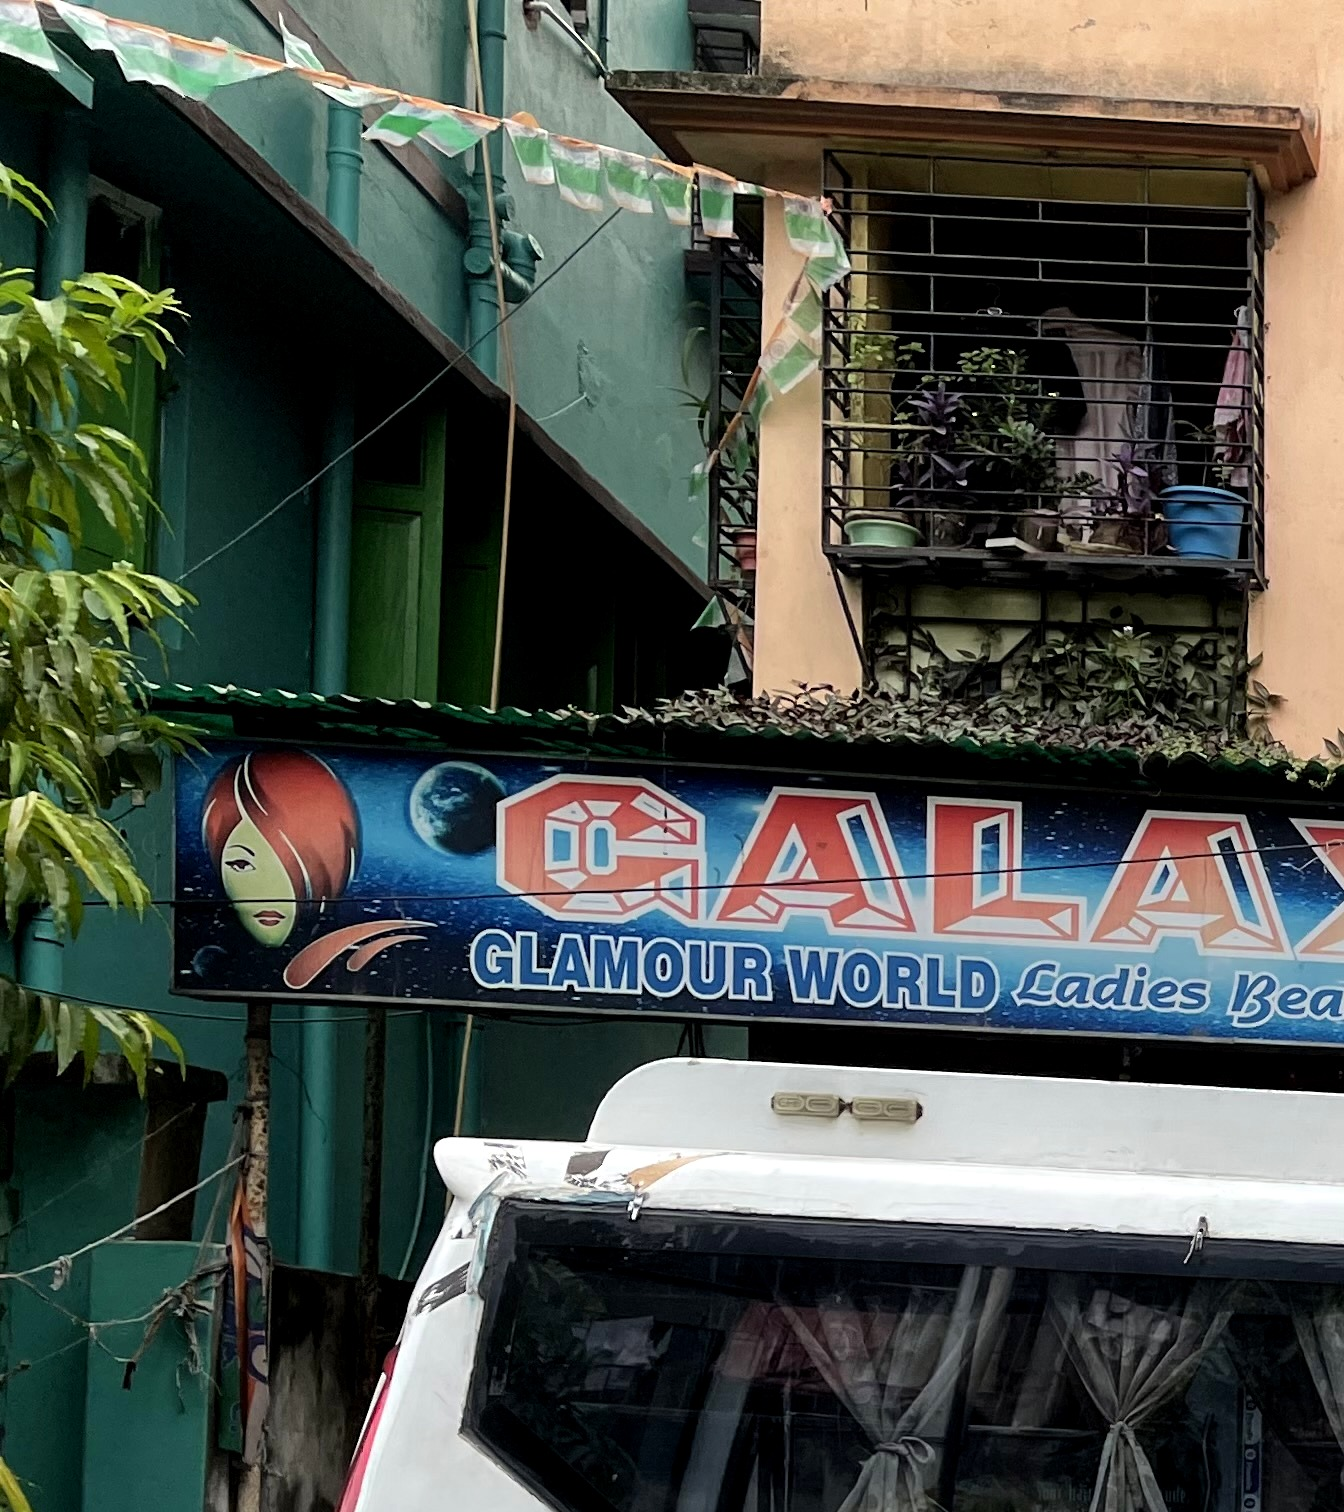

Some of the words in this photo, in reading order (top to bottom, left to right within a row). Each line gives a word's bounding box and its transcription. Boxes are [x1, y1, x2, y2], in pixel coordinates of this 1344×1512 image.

[470, 928, 773, 1002] GLAMOUR
[784, 943, 1000, 1013] WORLD
[1010, 962, 1209, 1010] Ladies
